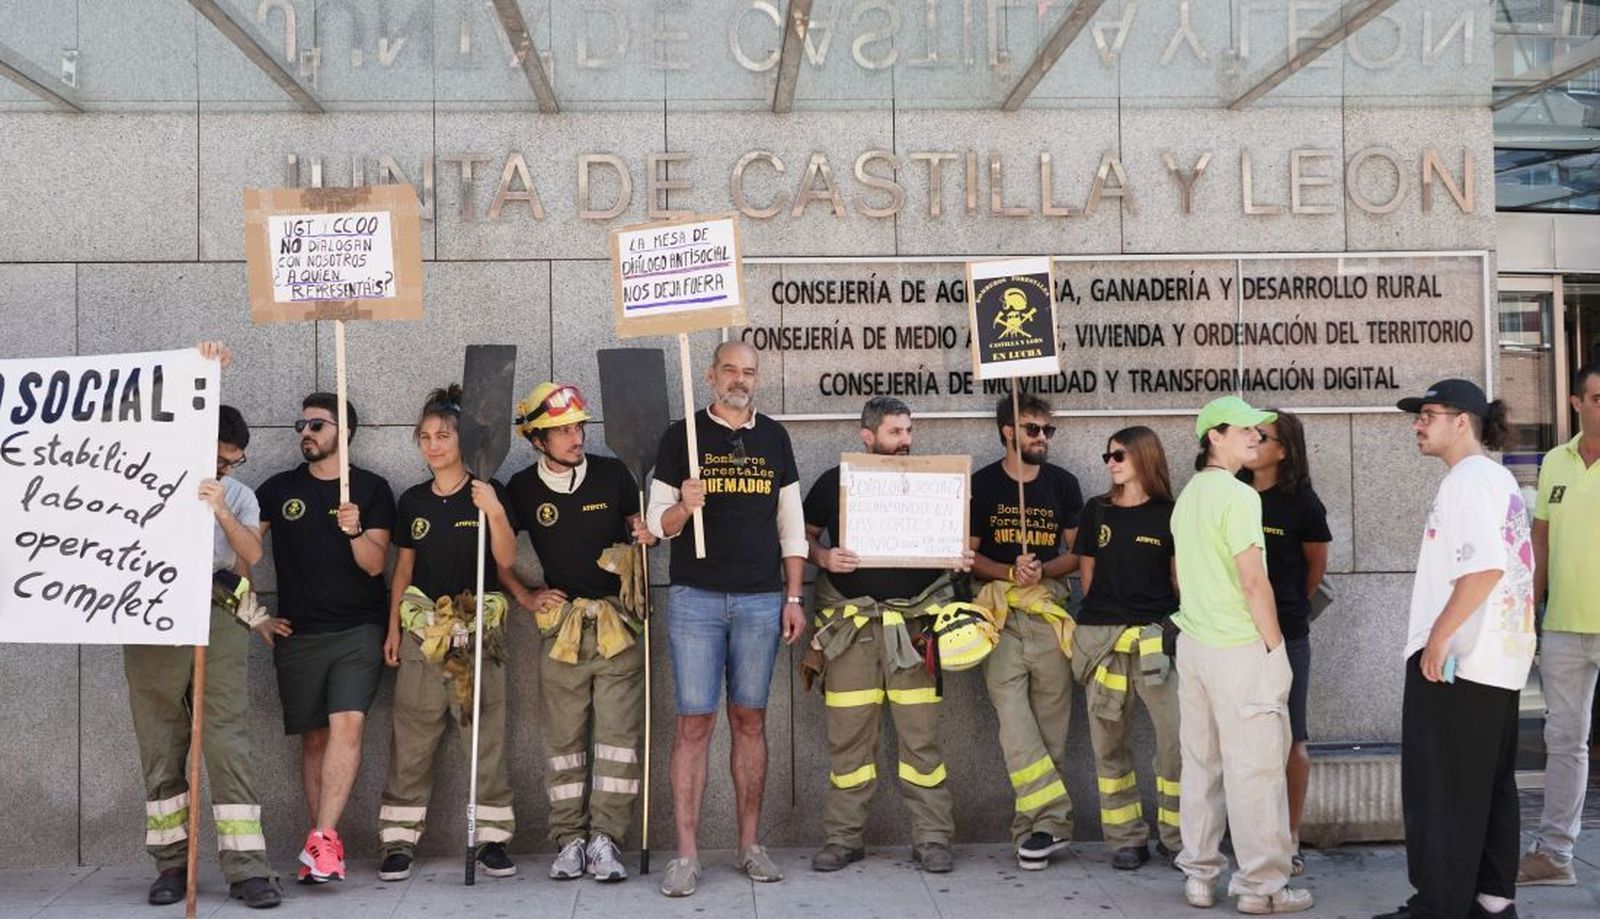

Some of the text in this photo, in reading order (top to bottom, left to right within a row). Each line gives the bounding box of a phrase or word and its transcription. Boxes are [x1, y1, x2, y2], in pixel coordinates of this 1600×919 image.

[577, 152, 695, 220] DE
[732, 149, 1138, 219] CASTILLA
[1163, 151, 1212, 215] Y
[1241, 146, 1475, 215] LEON
[284, 219, 315, 238] UGT
[333, 216, 378, 235] CCOO
[629, 227, 709, 252] LA MESA DE
[278, 253, 368, 269] CON NOSOTROS
[280, 238, 302, 254] NO
[623, 273, 724, 303] NOS DEJA FUERA
[772, 273, 892, 305] CONSEJERÍA
[902, 280, 926, 304] DE
[1091, 271, 1210, 302] GANADERÍA
[1219, 277, 1233, 300] Y
[1243, 275, 1368, 300] DESARROLLO
[1377, 275, 1442, 299] RURAL
[742, 319, 854, 351] CONSEJERÍA
[864, 326, 887, 350] DE
[896, 326, 957, 350] MEDIO
[1075, 323, 1165, 348] VIVIENDA
[1173, 323, 1186, 346] Y
[1194, 314, 1317, 347] ORDENACIÓN
[1326, 321, 1360, 345] DEL
[1366, 319, 1473, 344] TERRITORIO
[992, 348, 1043, 361] EN LUCHA
[819, 365, 940, 397] CONSEJERÍA
[949, 371, 974, 395] DE
[1105, 369, 1119, 393] Y
[1128, 360, 1315, 394] TRANSFORMACIÓN
[1323, 366, 1400, 391] DIGITAL
[1, 431, 188, 502] Estabilidad
[21, 475, 166, 528] laboral
[997, 503, 1054, 518] Bomeros
[15, 530, 178, 585] operativo
